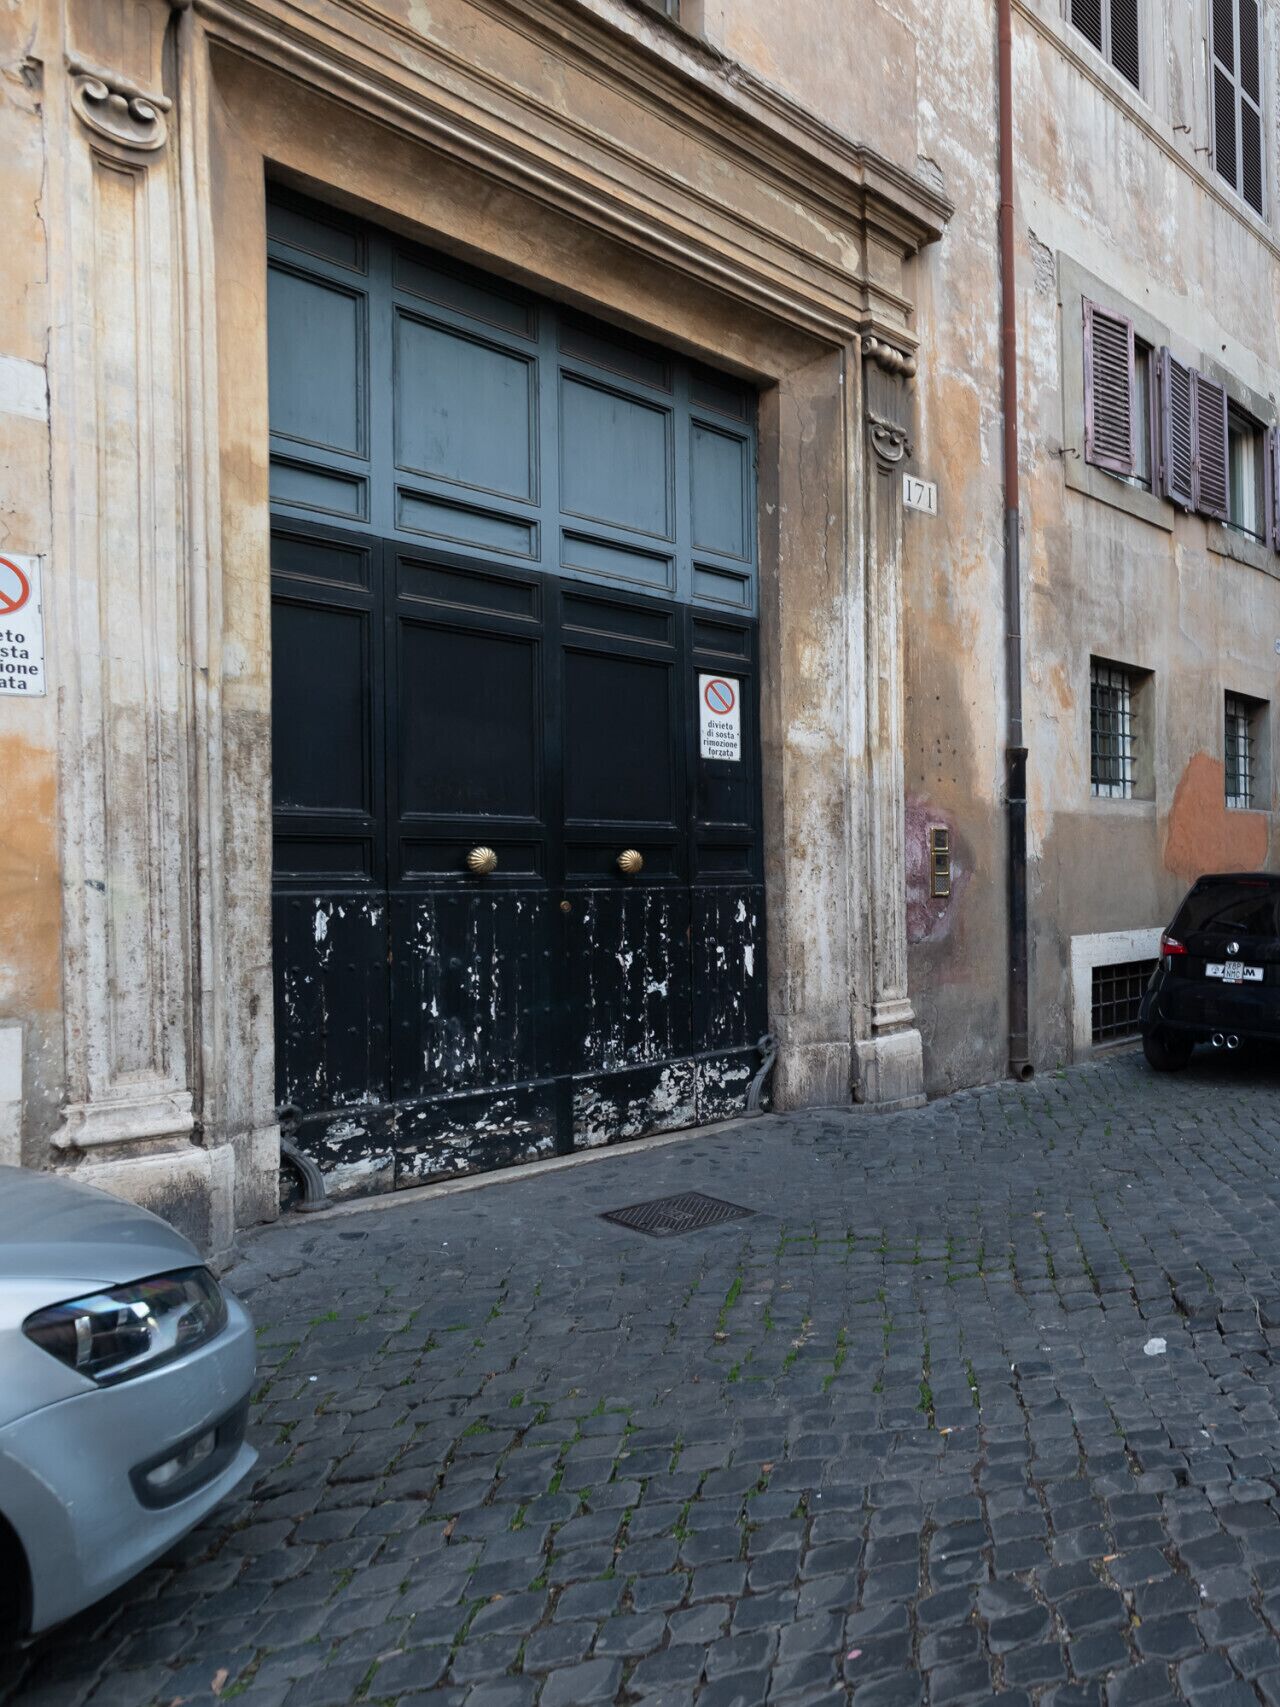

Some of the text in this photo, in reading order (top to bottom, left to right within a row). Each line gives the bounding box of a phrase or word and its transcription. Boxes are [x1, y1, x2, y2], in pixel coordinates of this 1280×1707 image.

[907, 480, 932, 510] 171
[707, 720, 733, 731] divieto
[706, 729, 735, 740] di sosta
[703, 738, 738, 749] rimozione
[708, 747, 734, 757] forzata
